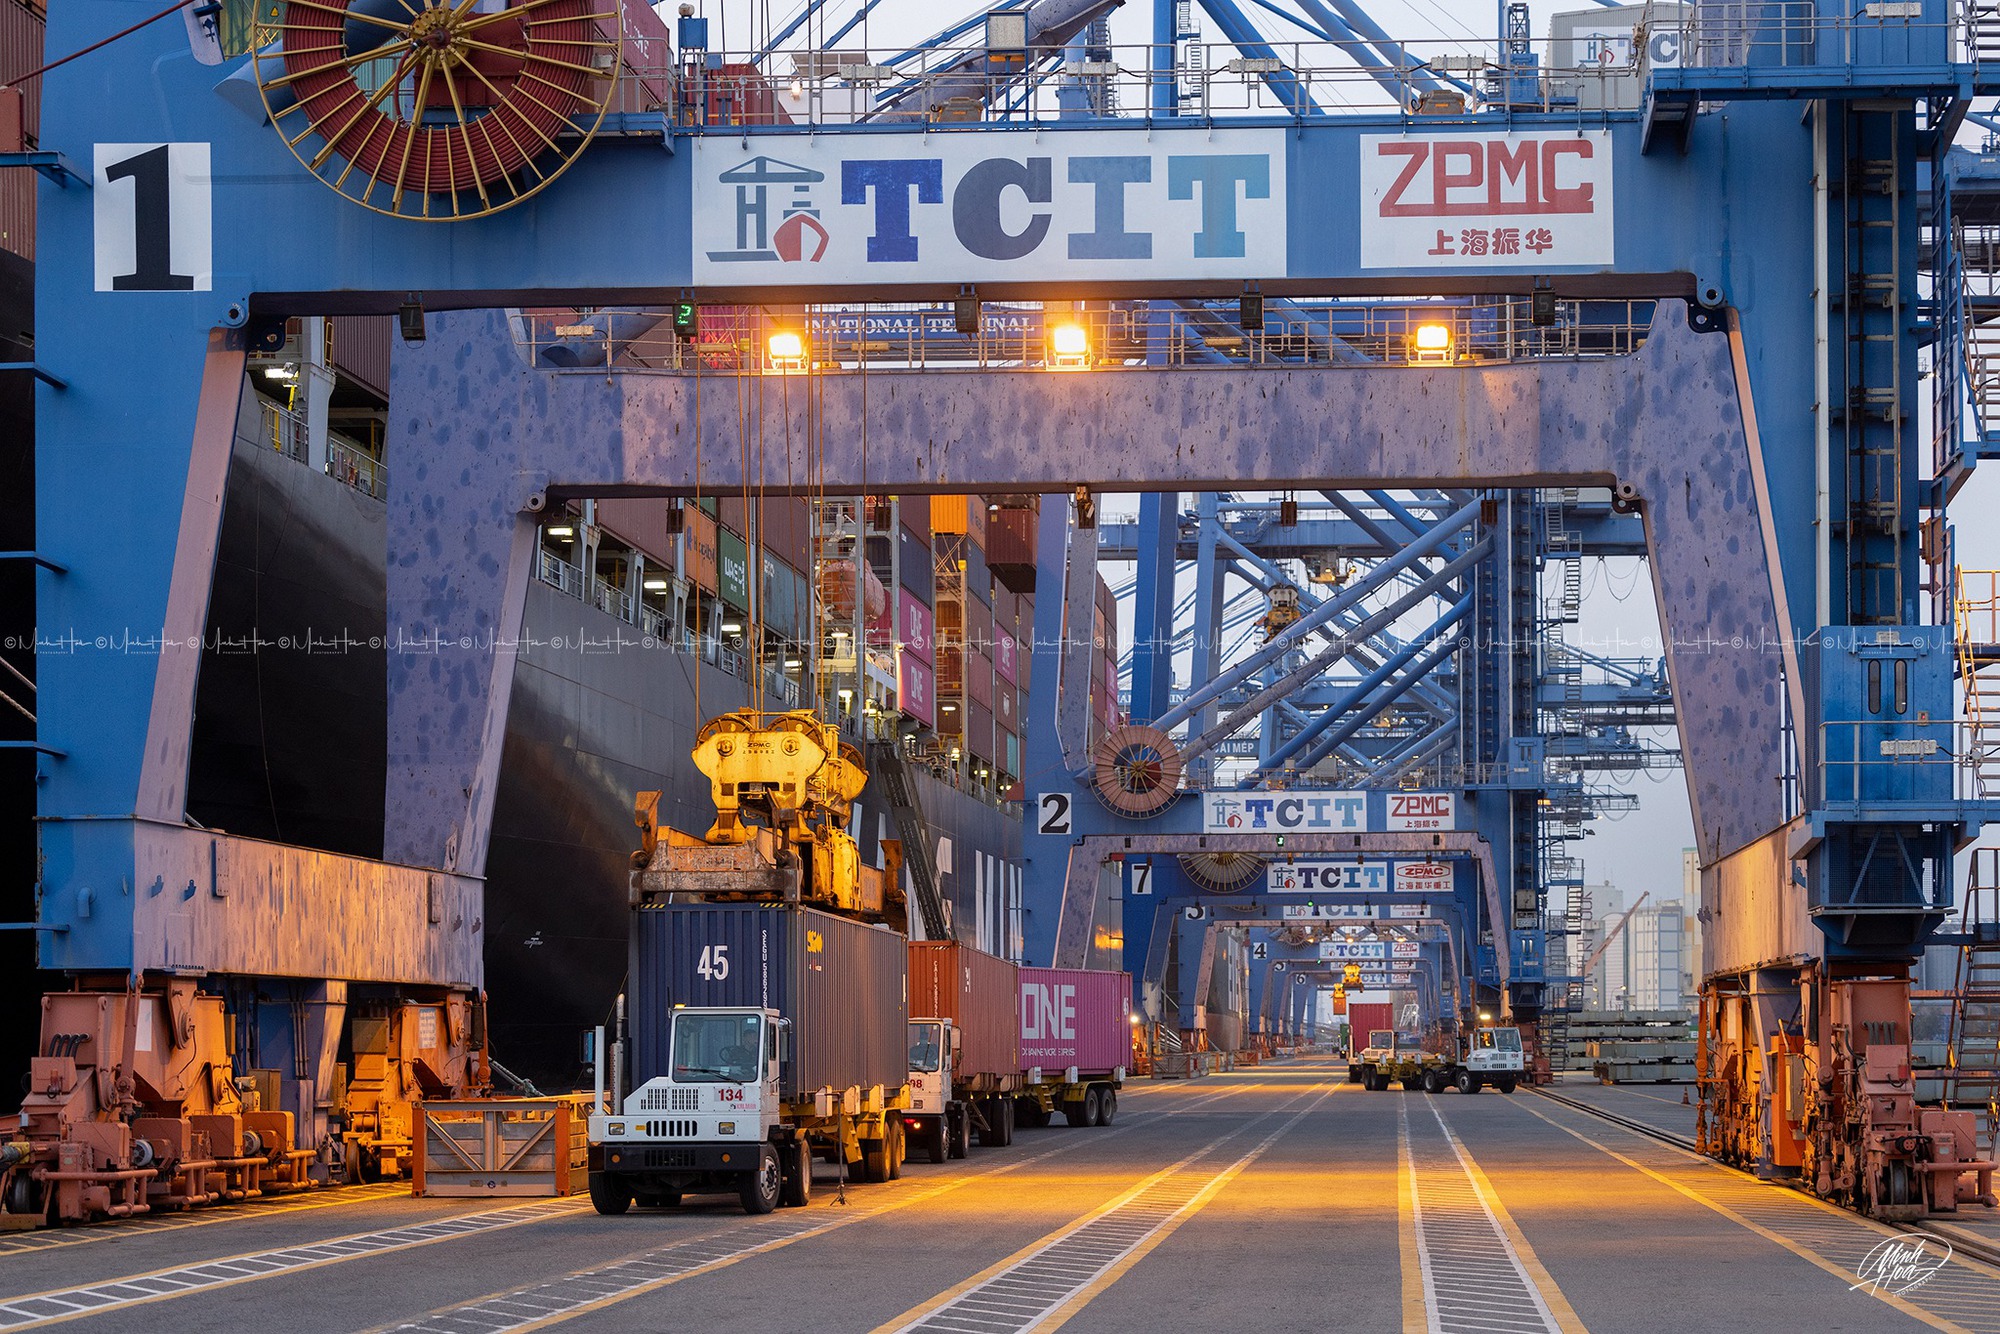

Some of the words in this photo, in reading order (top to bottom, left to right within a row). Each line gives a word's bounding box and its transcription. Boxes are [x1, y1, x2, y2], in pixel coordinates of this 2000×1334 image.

[1378, 139, 1594, 218] ZPMC
[105, 144, 194, 291] 1
[841, 153, 1270, 262] TCIT
[1428, 228, 1554, 256] 上海振华
[677, 304, 692, 325] 2
[926, 317, 1035, 333] TEINAL
[1040, 793, 1070, 834] 2
[1245, 798, 1363, 828] TCIT
[1391, 795, 1450, 817] ZPMC
[1133, 865, 1150, 893] 7
[1297, 867, 1385, 889] TCIT
[1405, 867, 1443, 876] ZPMC
[697, 945, 729, 981] 45
[1253, 943, 1267, 959] 4
[1336, 945, 1383, 956] TCIT
[1296, 974, 1305, 984] 6
[1021, 983, 1075, 1040] ONE
[718, 1089, 744, 1102] 134
